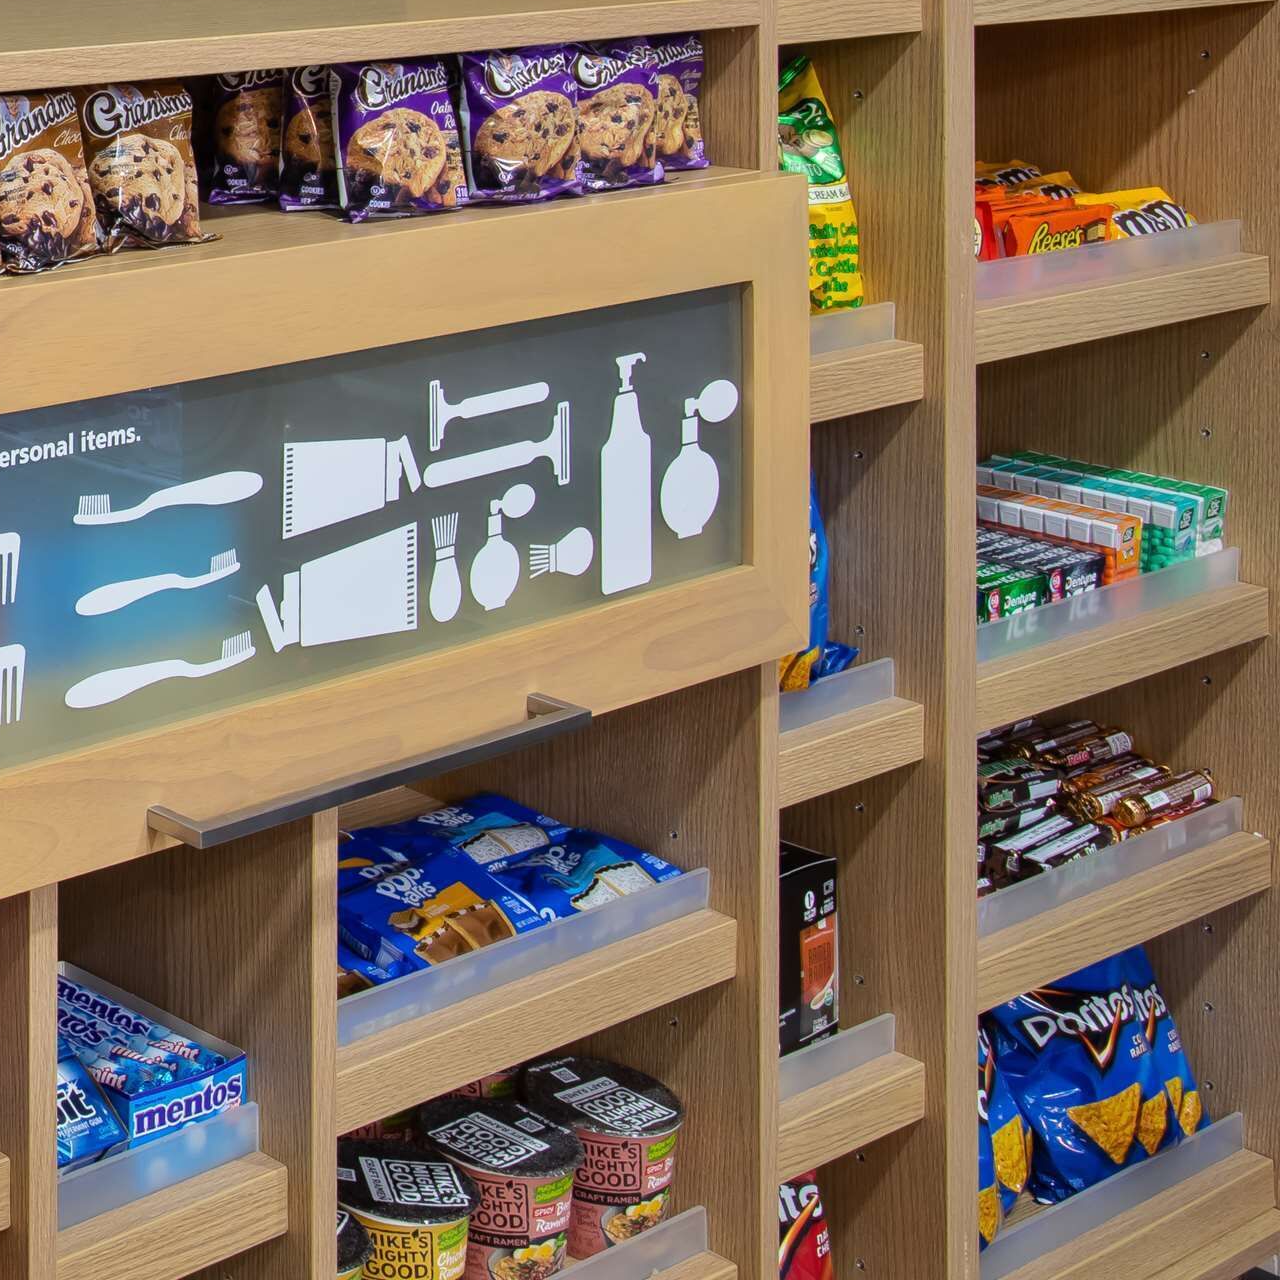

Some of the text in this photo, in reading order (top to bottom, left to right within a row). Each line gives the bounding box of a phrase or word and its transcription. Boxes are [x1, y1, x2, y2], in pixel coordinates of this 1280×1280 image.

[1028, 222, 1084, 255] Reese's
[81, 425, 141, 453] items.
[1022, 984, 1135, 1047] Doritos
[134, 1074, 242, 1137] mentos
[410, 1164, 436, 1204] MIGHTY
[575, 1190, 640, 1204] CRAFT RAMEN
[493, 1235, 528, 1247] RAMEN
